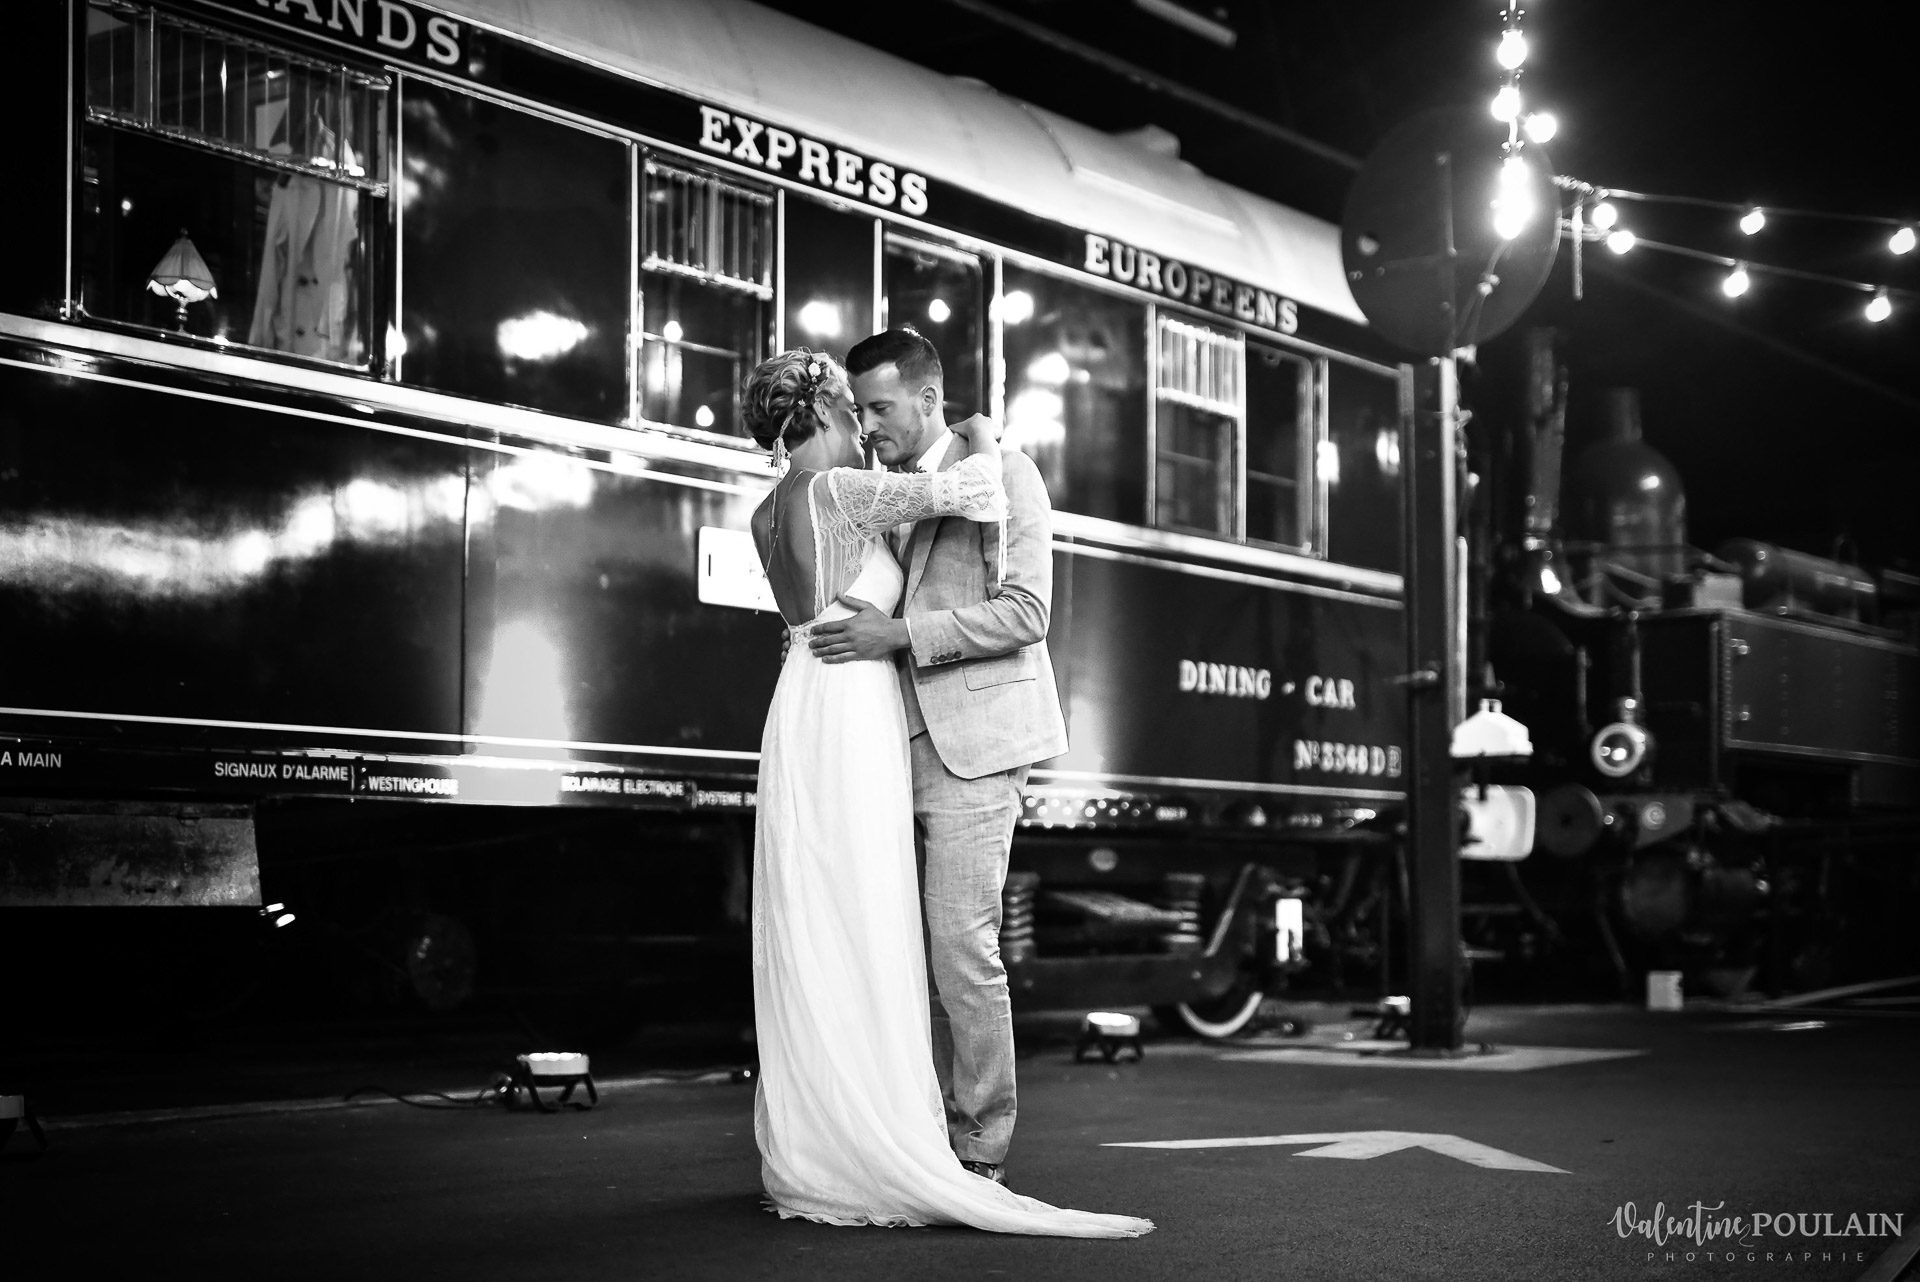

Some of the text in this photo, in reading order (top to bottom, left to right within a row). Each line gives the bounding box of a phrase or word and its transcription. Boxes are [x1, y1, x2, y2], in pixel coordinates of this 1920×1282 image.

[699, 105, 1298, 335] EXPRESS EUROPEENS
[1179, 659, 1271, 700] DINING
[1304, 674, 1356, 710] CAR
[18, 752, 62, 768] MAIN
[214, 761, 349, 781] SIGNAUX D'ALARME
